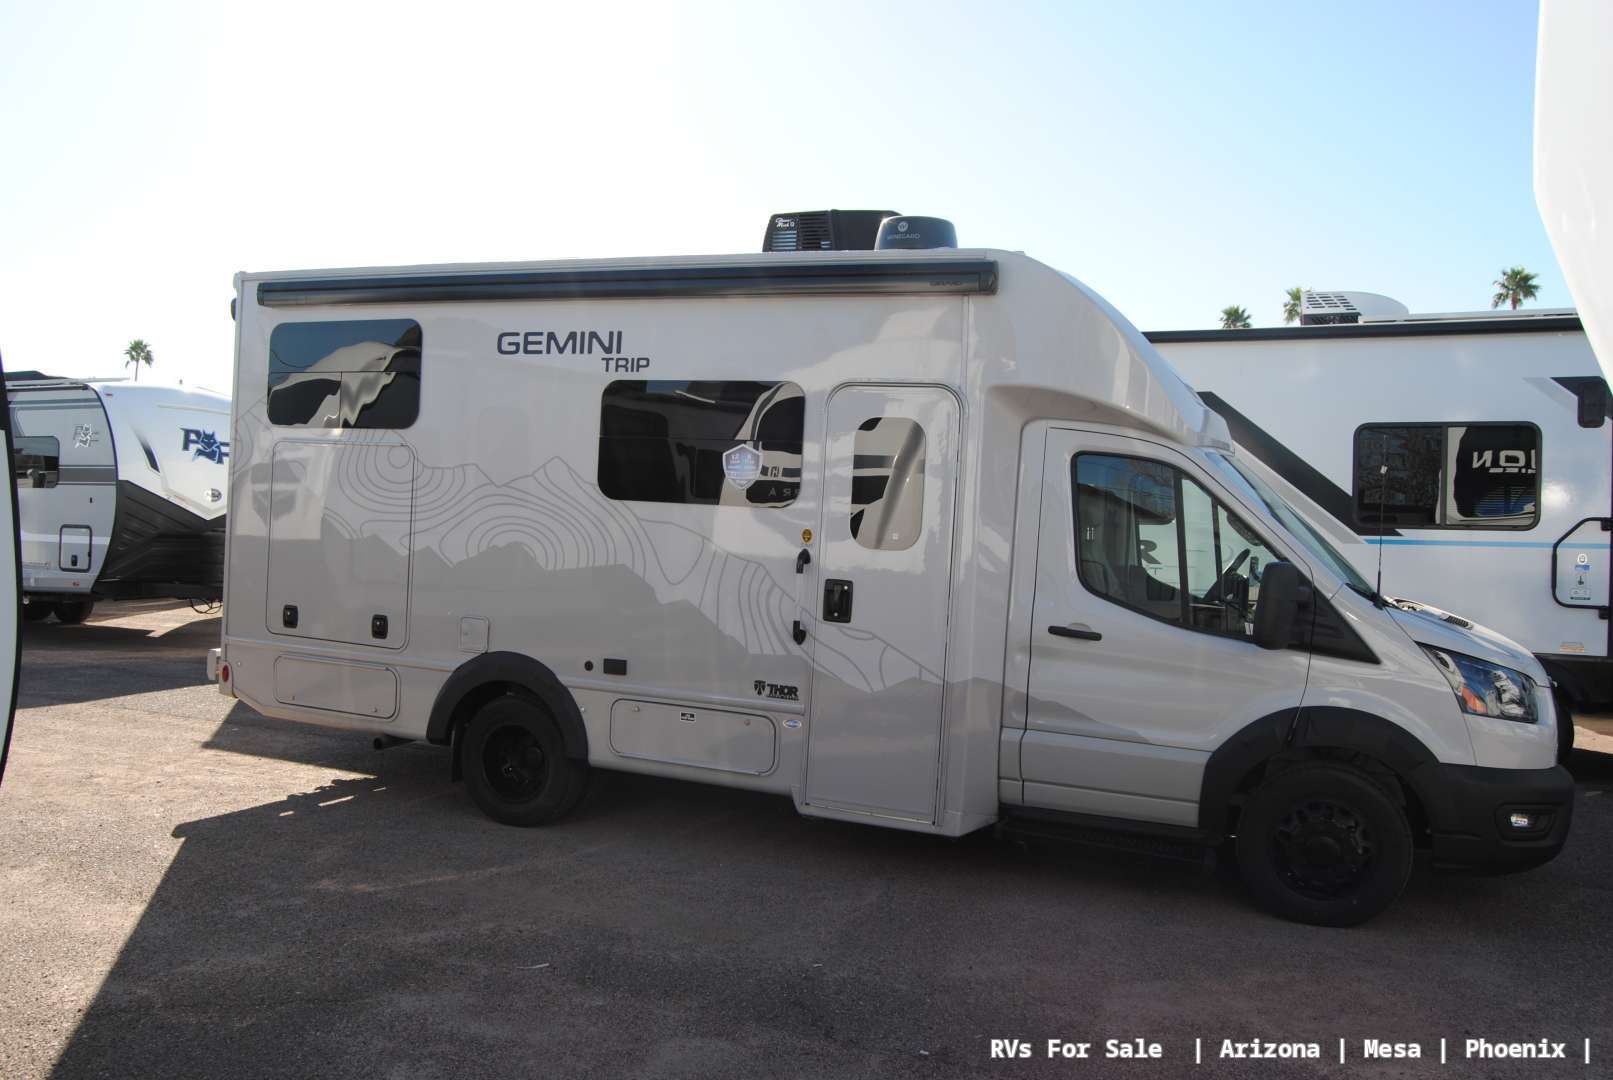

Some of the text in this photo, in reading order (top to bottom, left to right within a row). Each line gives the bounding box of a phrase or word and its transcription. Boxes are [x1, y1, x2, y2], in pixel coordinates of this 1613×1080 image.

[497, 330, 623, 355] GEMINI
[601, 357, 650, 373] TRIP
[767, 683, 798, 698] THOR
